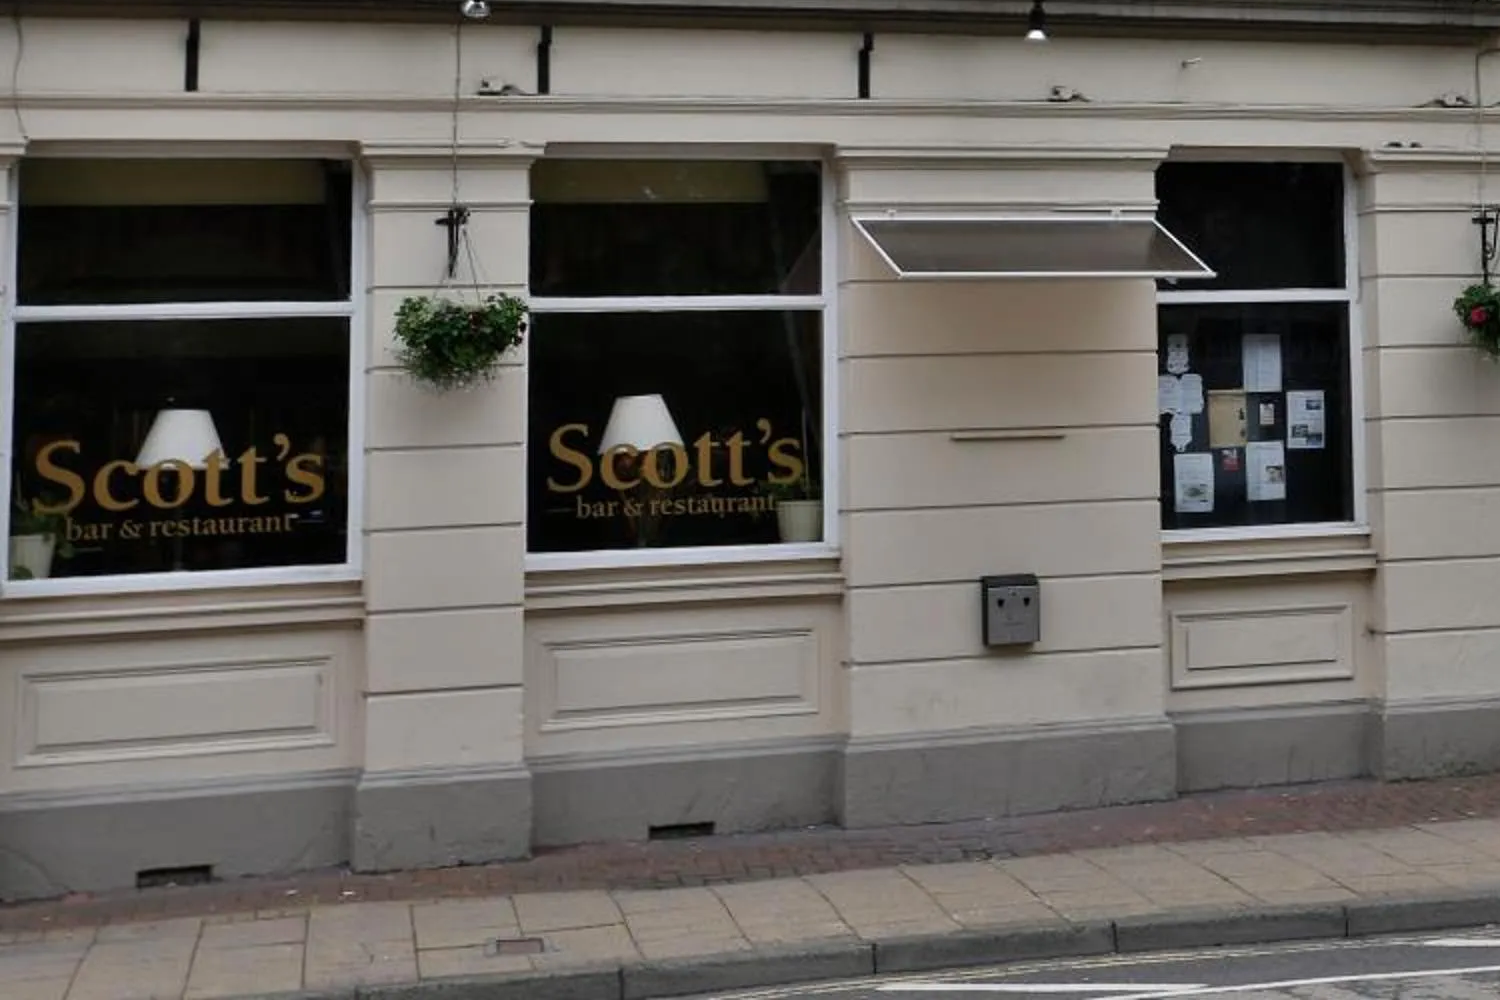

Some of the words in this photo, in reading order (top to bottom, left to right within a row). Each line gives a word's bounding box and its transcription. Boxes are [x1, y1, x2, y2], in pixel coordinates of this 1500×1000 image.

[31, 433, 326, 513] Scott's
[546, 417, 805, 493] Scott's
[65, 516, 113, 541] bar
[119, 518, 145, 538] &
[150, 512, 294, 538] restaurant
[575, 495, 620, 519] bar
[623, 499, 644, 518] &
[649, 494, 776, 518] restaurant
